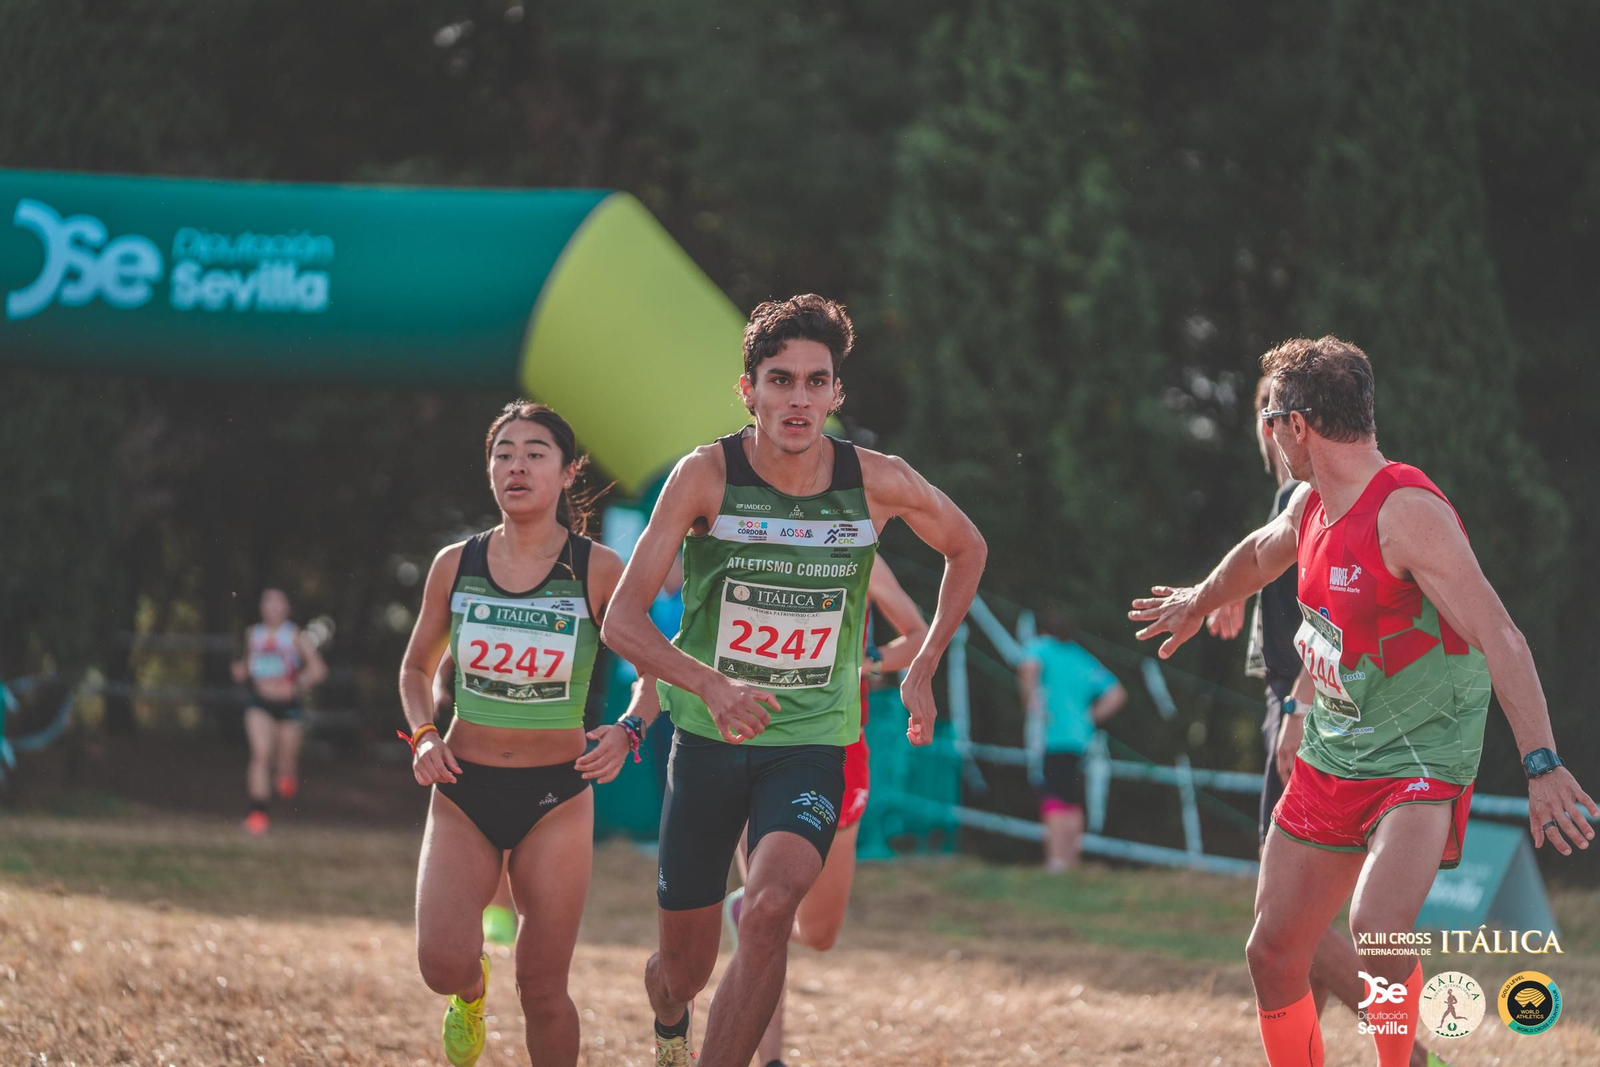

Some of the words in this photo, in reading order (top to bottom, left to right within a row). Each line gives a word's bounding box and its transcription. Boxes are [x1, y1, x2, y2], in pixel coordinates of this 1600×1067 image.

[171, 259, 329, 312] Sevilla
[726, 556, 793, 574] ATLETISMO
[797, 562, 858, 578] CORDOBÉS
[758, 590, 815, 606] ITÁLICA
[496, 608, 548, 625] ITÁLICA
[729, 620, 832, 660] 2247
[470, 639, 564, 678] 2247
